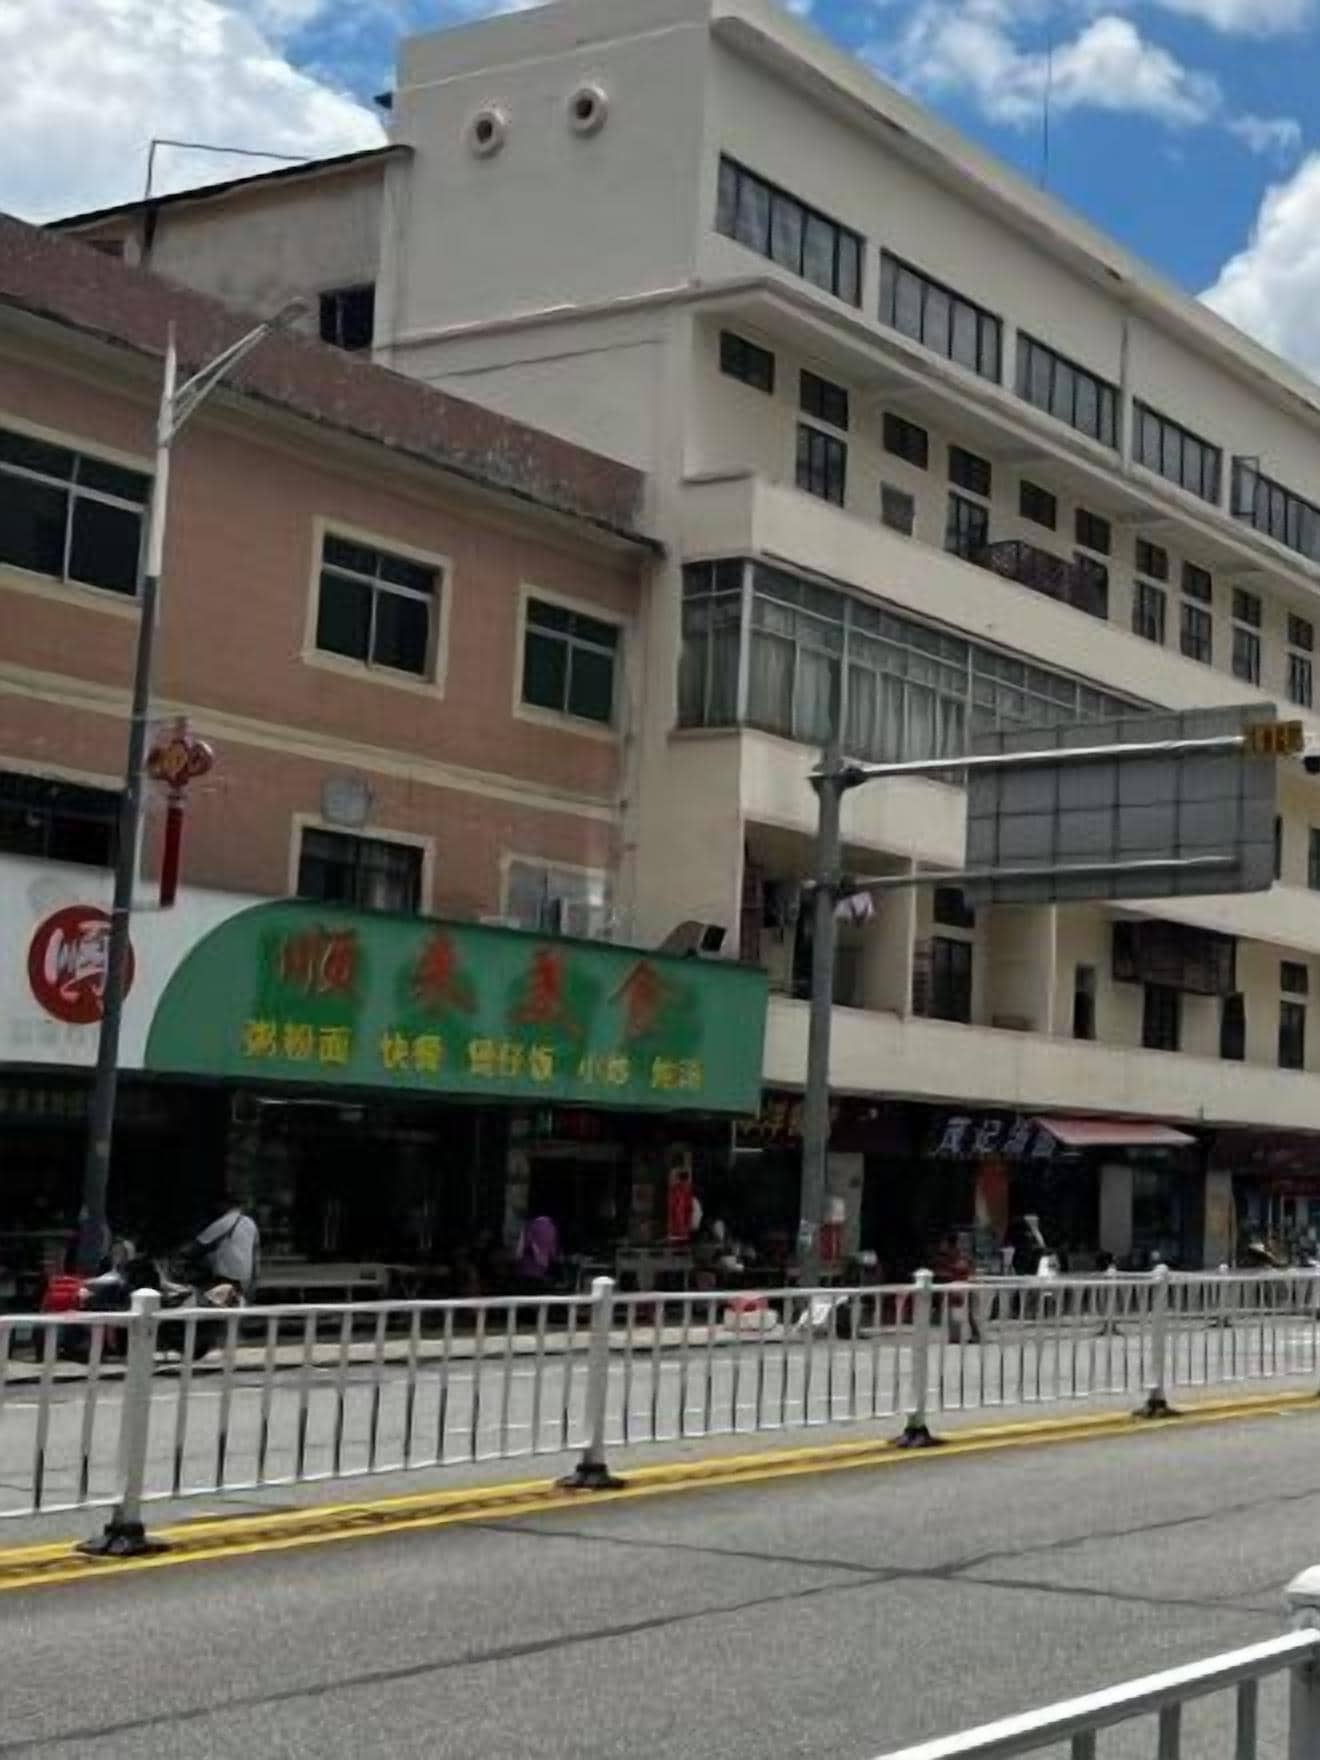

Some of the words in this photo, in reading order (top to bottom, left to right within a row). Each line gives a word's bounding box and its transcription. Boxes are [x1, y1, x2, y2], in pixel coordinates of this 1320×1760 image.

[244, 1017, 351, 1064] 粥粉面
[381, 1030, 444, 1073] 快餐
